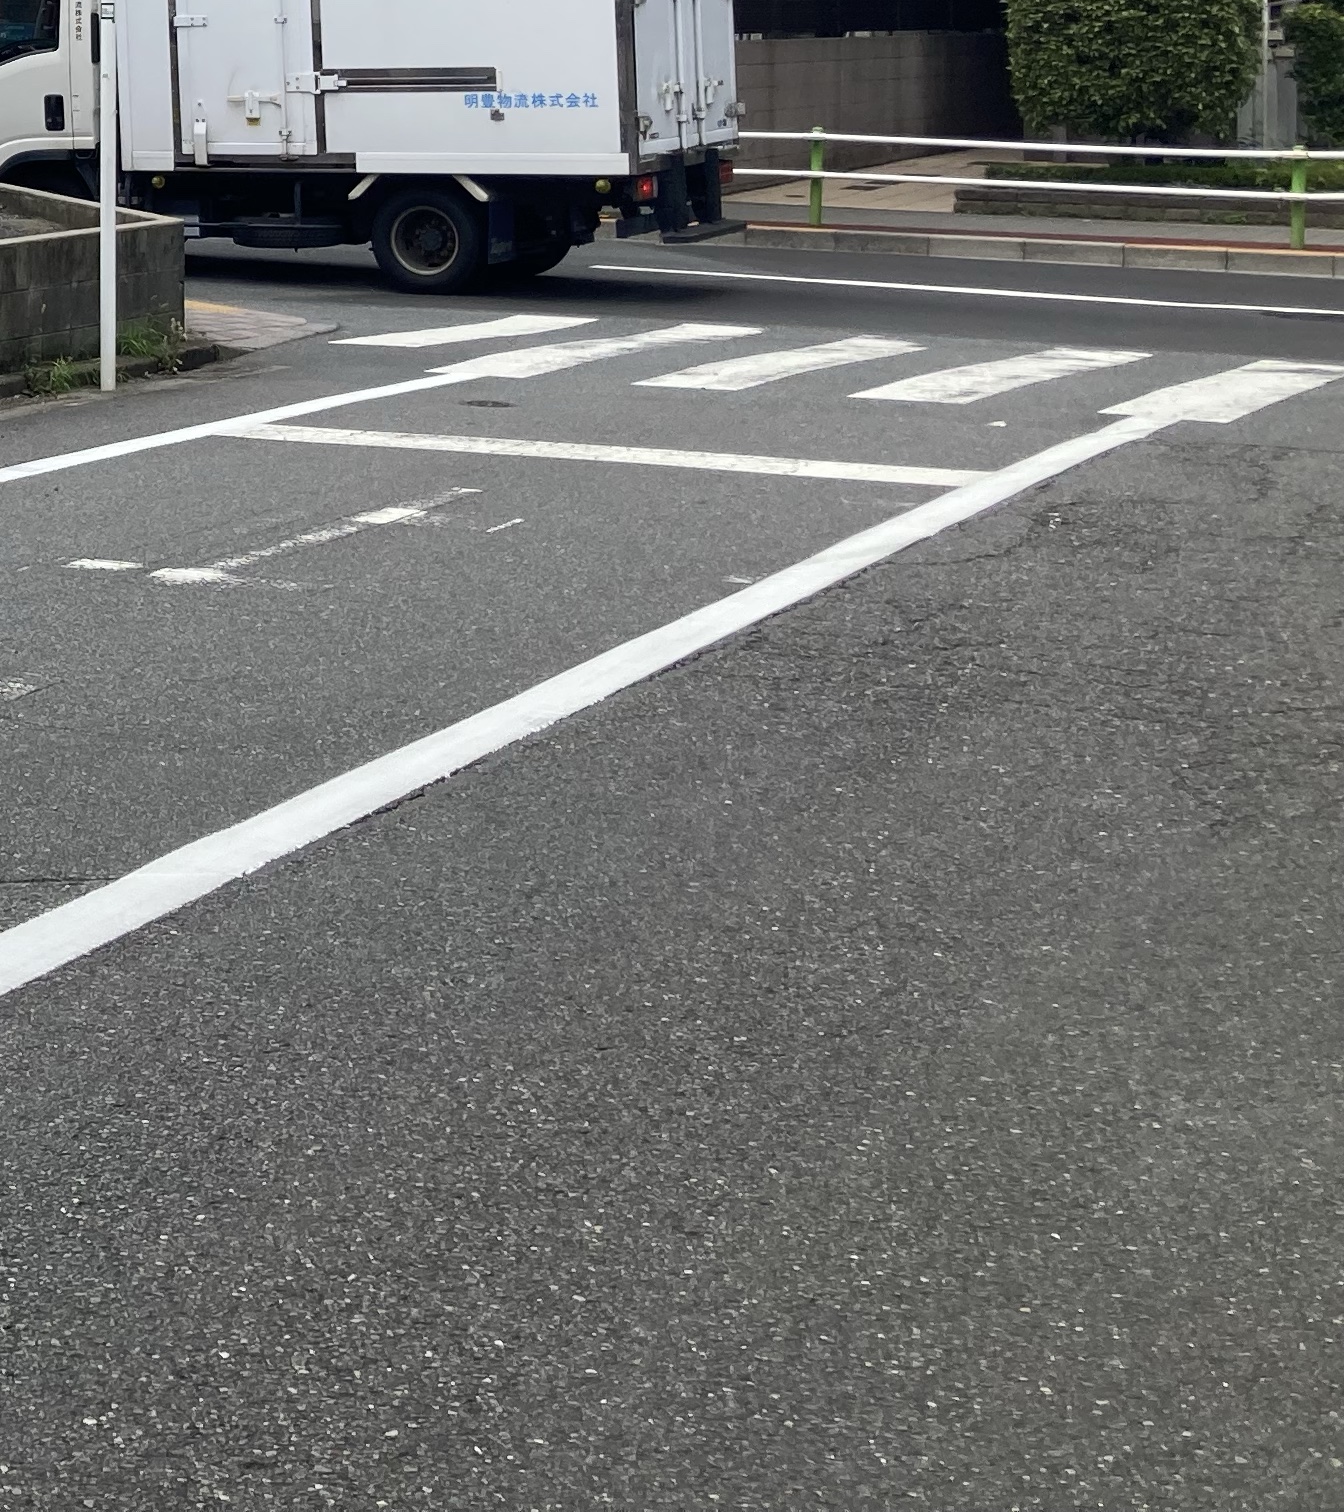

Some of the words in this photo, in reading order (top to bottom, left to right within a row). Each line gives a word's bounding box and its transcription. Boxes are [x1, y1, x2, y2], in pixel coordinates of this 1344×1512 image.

[464, 92, 599, 109] 明豊物流株式会社
